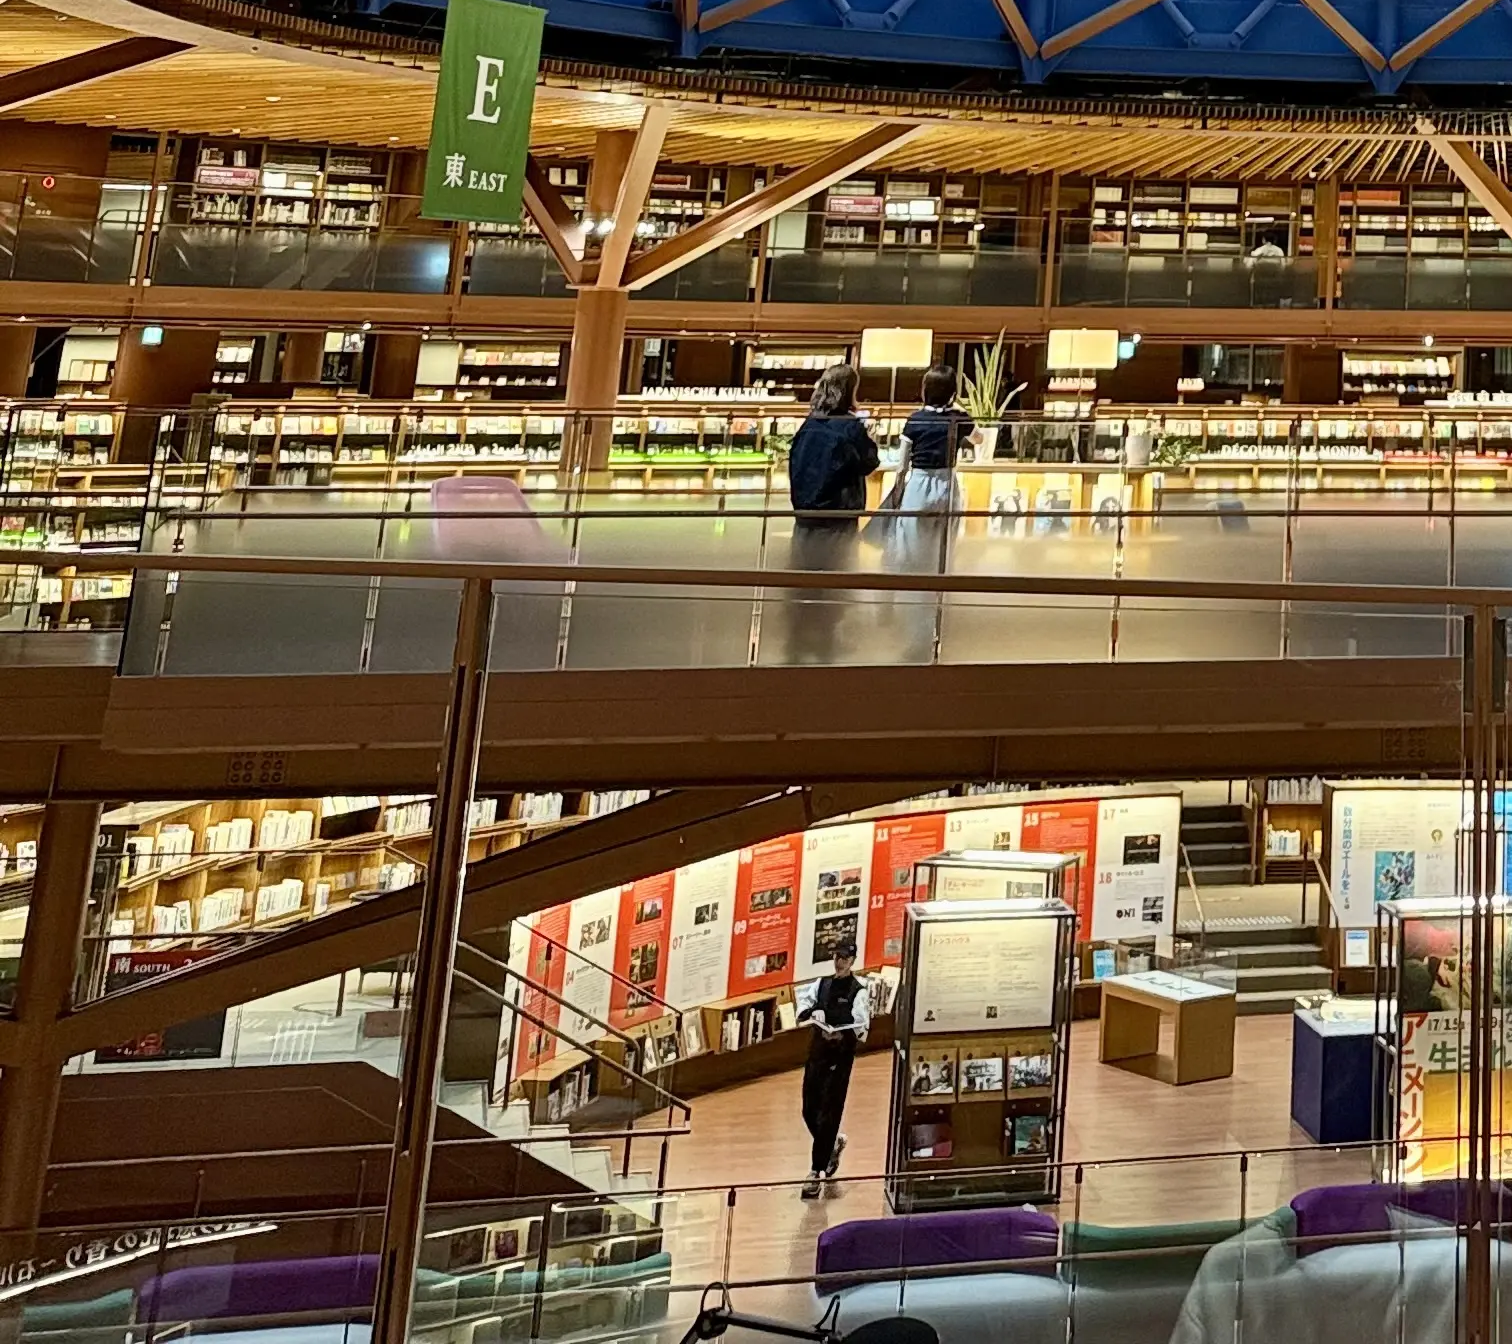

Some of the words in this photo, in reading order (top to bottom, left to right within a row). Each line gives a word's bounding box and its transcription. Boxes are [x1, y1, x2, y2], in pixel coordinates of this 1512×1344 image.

[466, 55, 505, 124] E
[443, 152, 466, 188] 東
[467, 170, 507, 194] EAST
[719, 387, 769, 397] KULTUR
[134, 963, 170, 974] SOUTH
